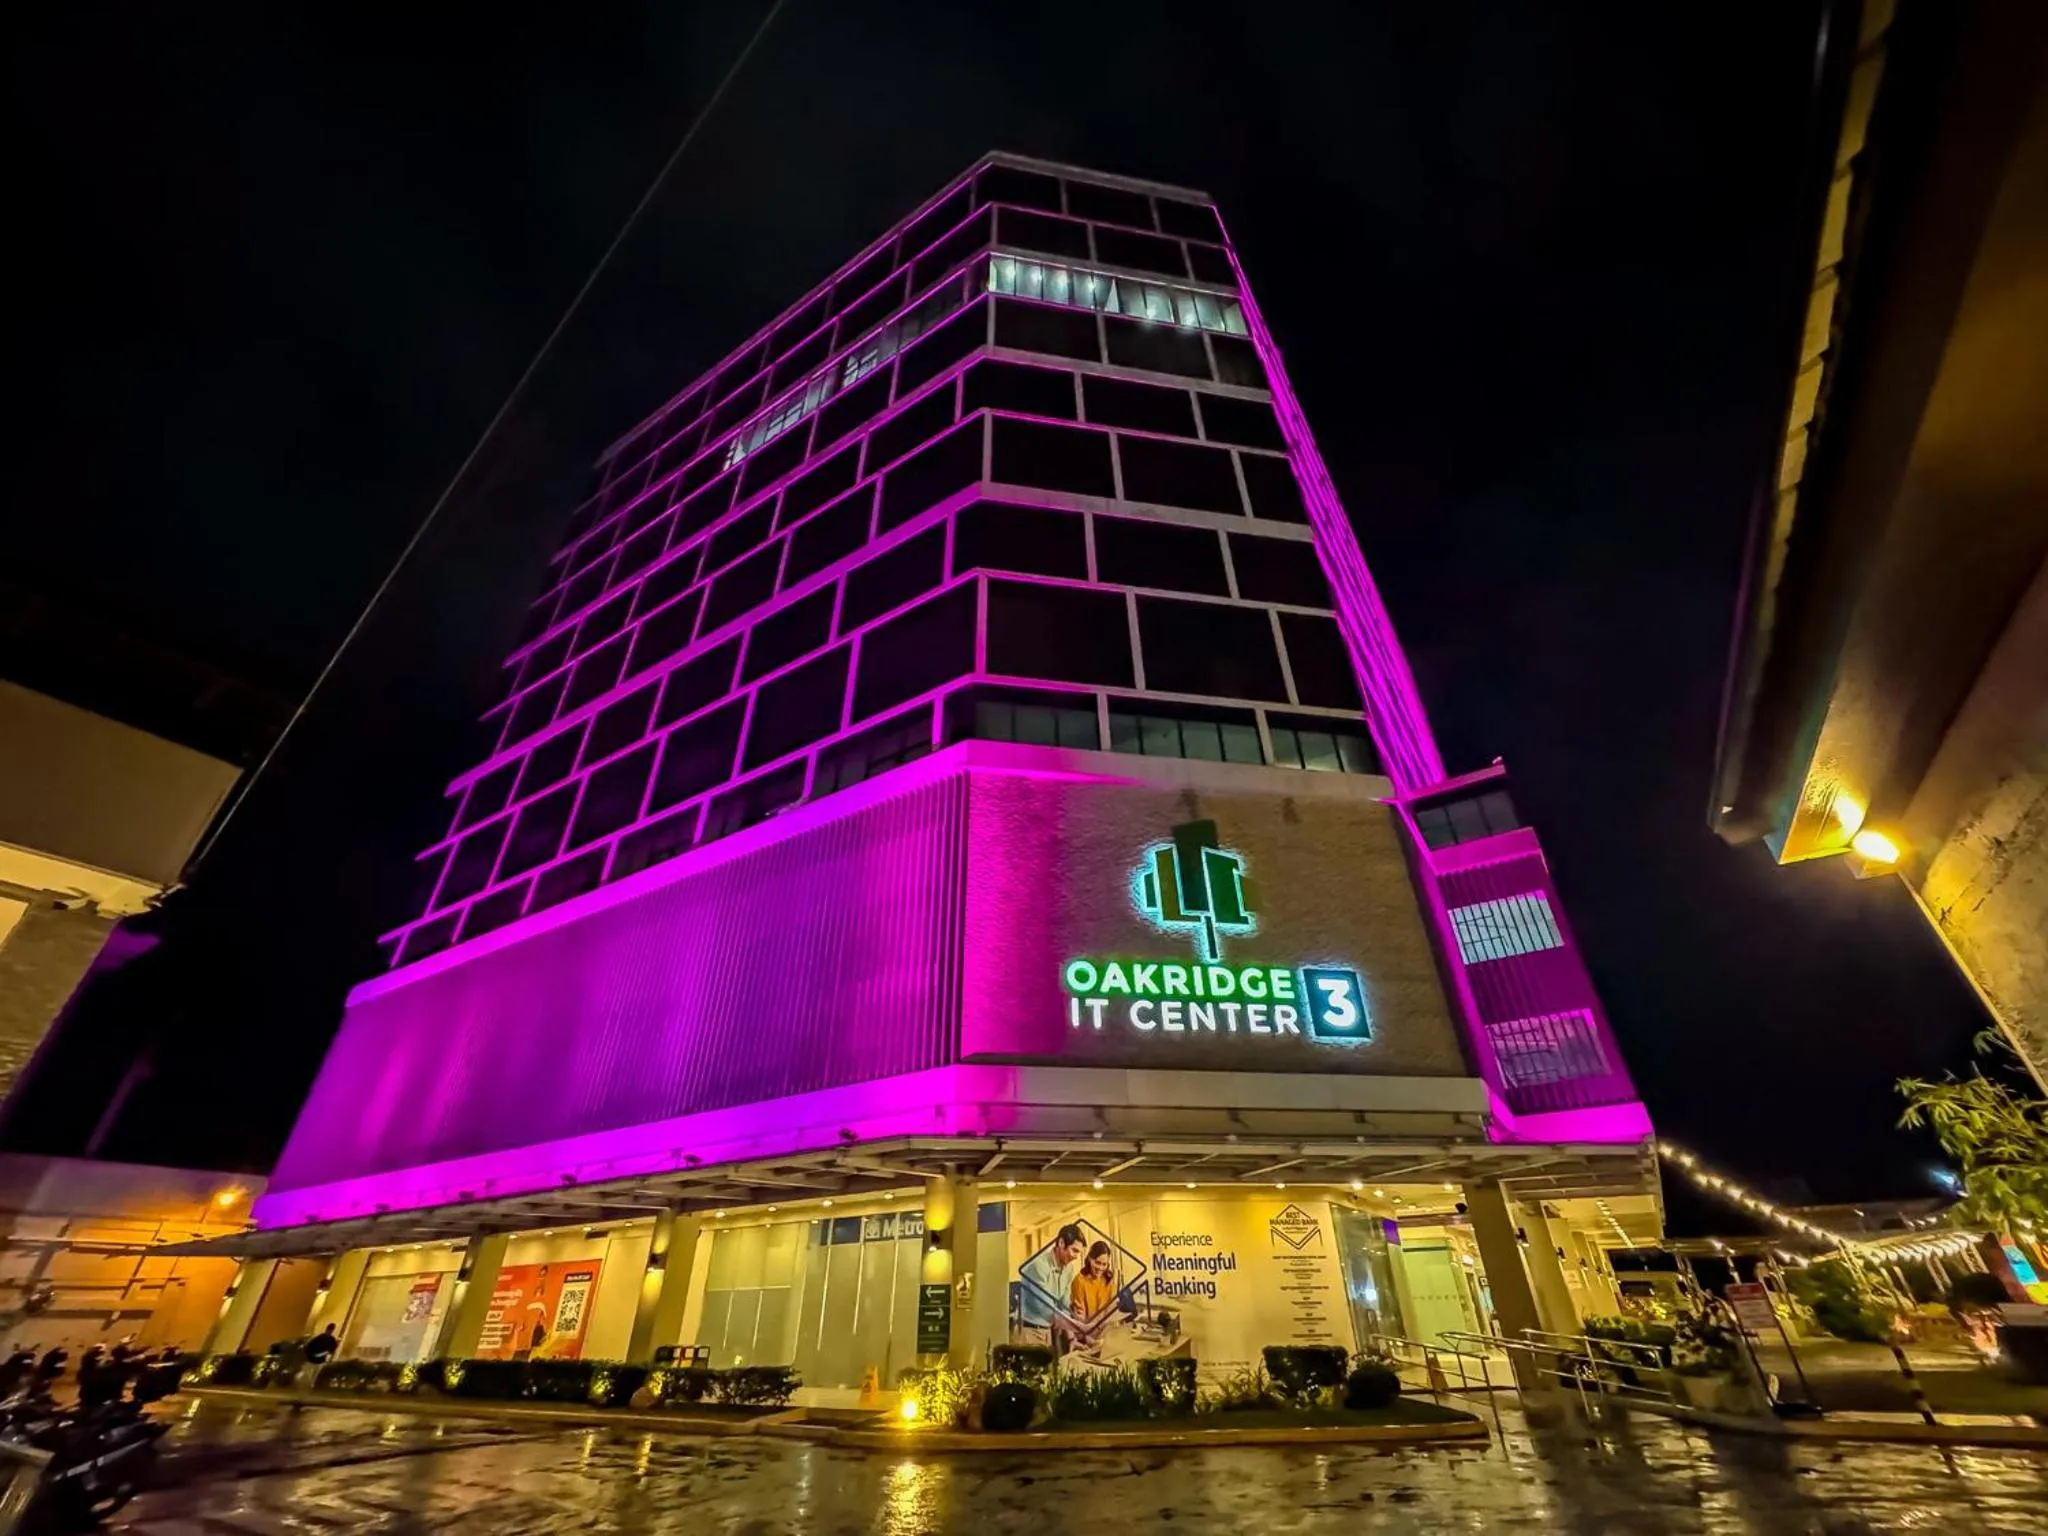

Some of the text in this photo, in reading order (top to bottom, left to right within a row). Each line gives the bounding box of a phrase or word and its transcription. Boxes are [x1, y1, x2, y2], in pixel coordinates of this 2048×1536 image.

[1066, 960, 1296, 999] OAKRIDGE
[1071, 978, 1357, 1034] IT CENTER 3
[1150, 1231, 1213, 1248] Experience
[1152, 1252, 1237, 1275] Meaningful
[1154, 1276, 1217, 1299] Banking
